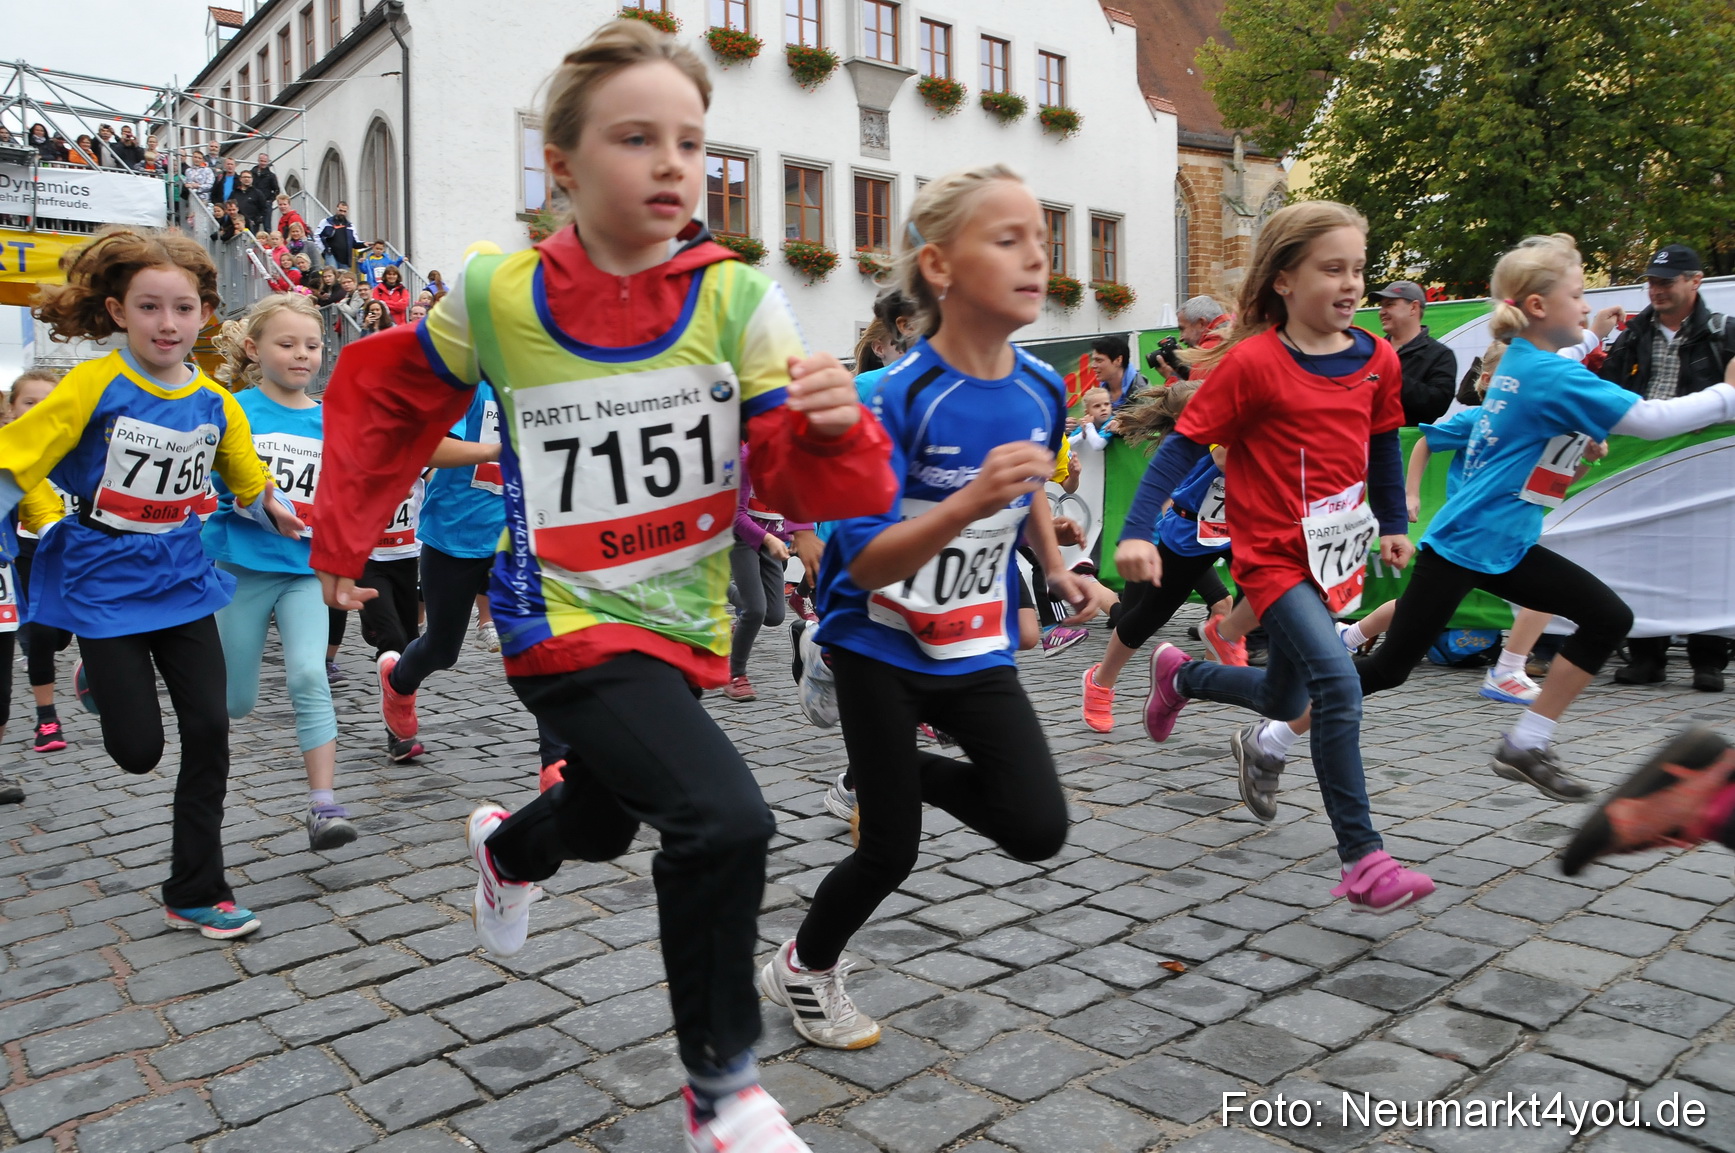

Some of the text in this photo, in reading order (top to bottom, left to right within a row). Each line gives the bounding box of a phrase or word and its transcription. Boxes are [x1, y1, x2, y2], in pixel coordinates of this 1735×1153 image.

[0, 173, 91, 197] Dynamics
[0, 192, 19, 203] ehr
[0, 240, 35, 273] T
[521, 388, 702, 429] PARTL Neumarkt
[117, 428, 163, 450] PARTL
[258, 441, 322, 459] RTL Neumar
[122, 449, 206, 495] 7156
[543, 413, 715, 513] 7151
[141, 504, 180, 520] Sofia
[600, 519, 687, 560] Selina
[1307, 525, 1341, 540] PARTL
